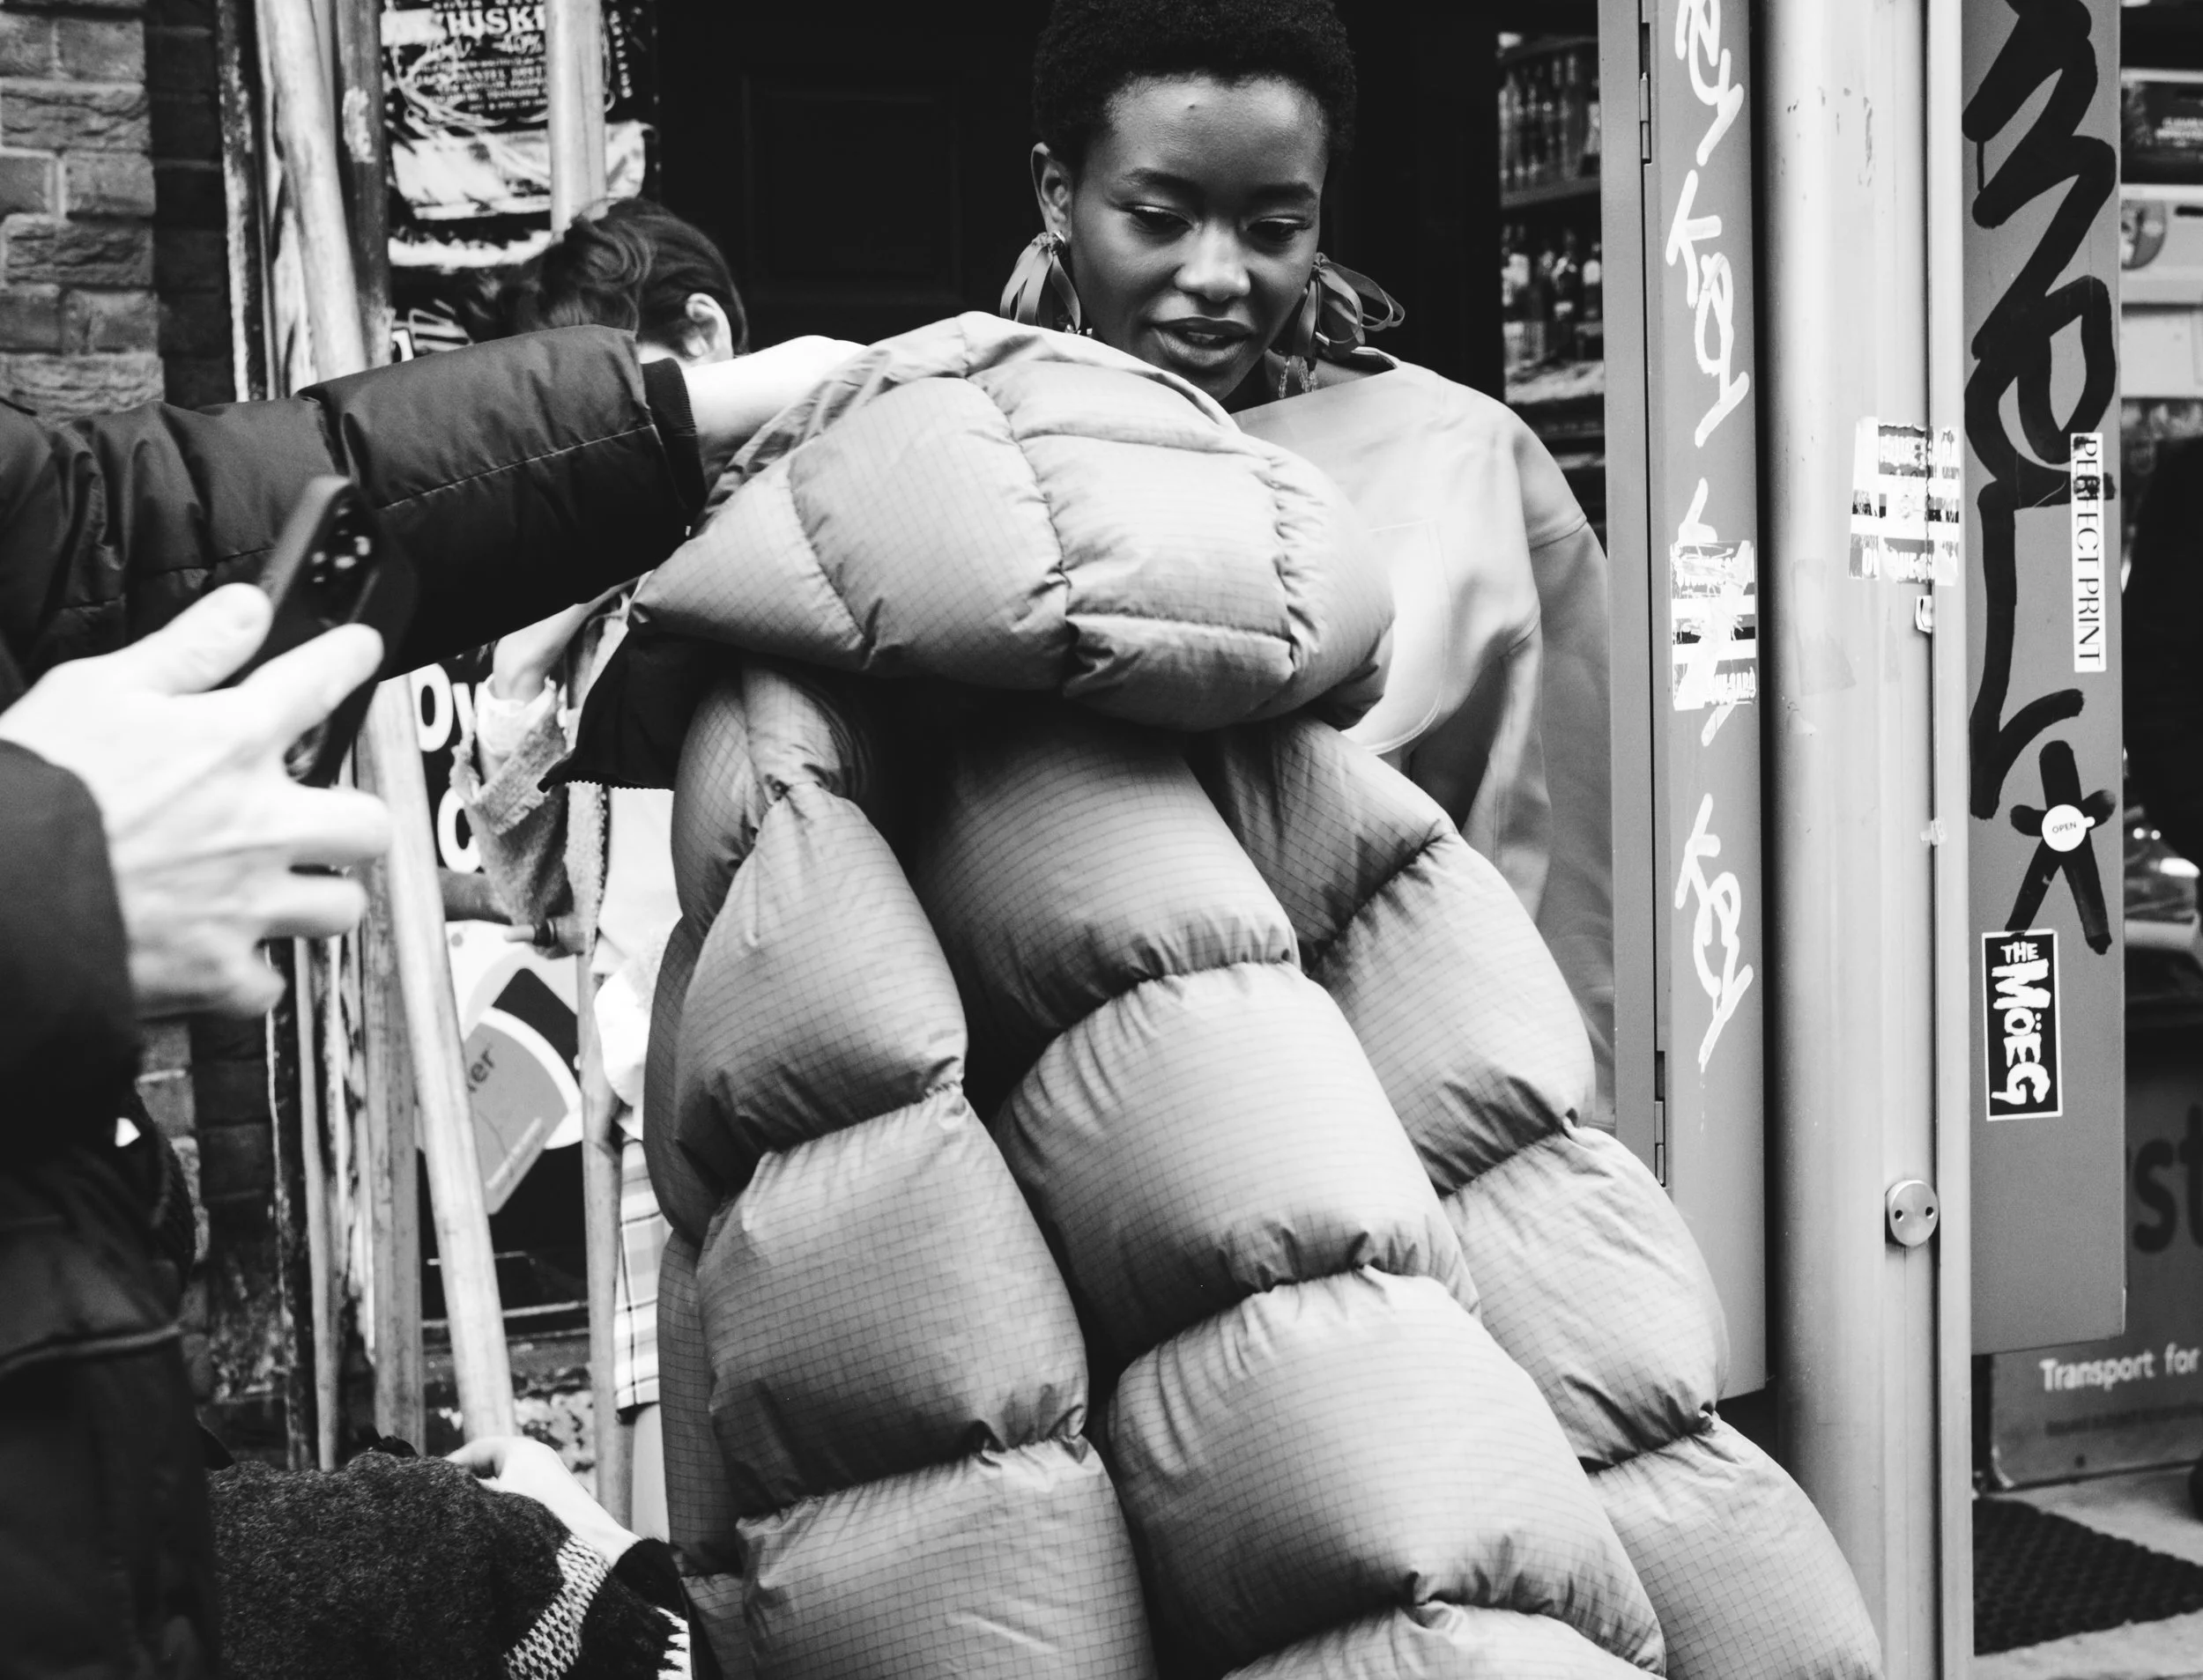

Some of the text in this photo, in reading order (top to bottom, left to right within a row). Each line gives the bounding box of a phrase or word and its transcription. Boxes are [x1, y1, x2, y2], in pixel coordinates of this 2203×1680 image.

[2077, 578, 2101, 666] PRINT
[2052, 820, 2077, 834] OPEN
[2000, 941, 2039, 964] THE
[2039, 1341, 2201, 1393] Transport for
